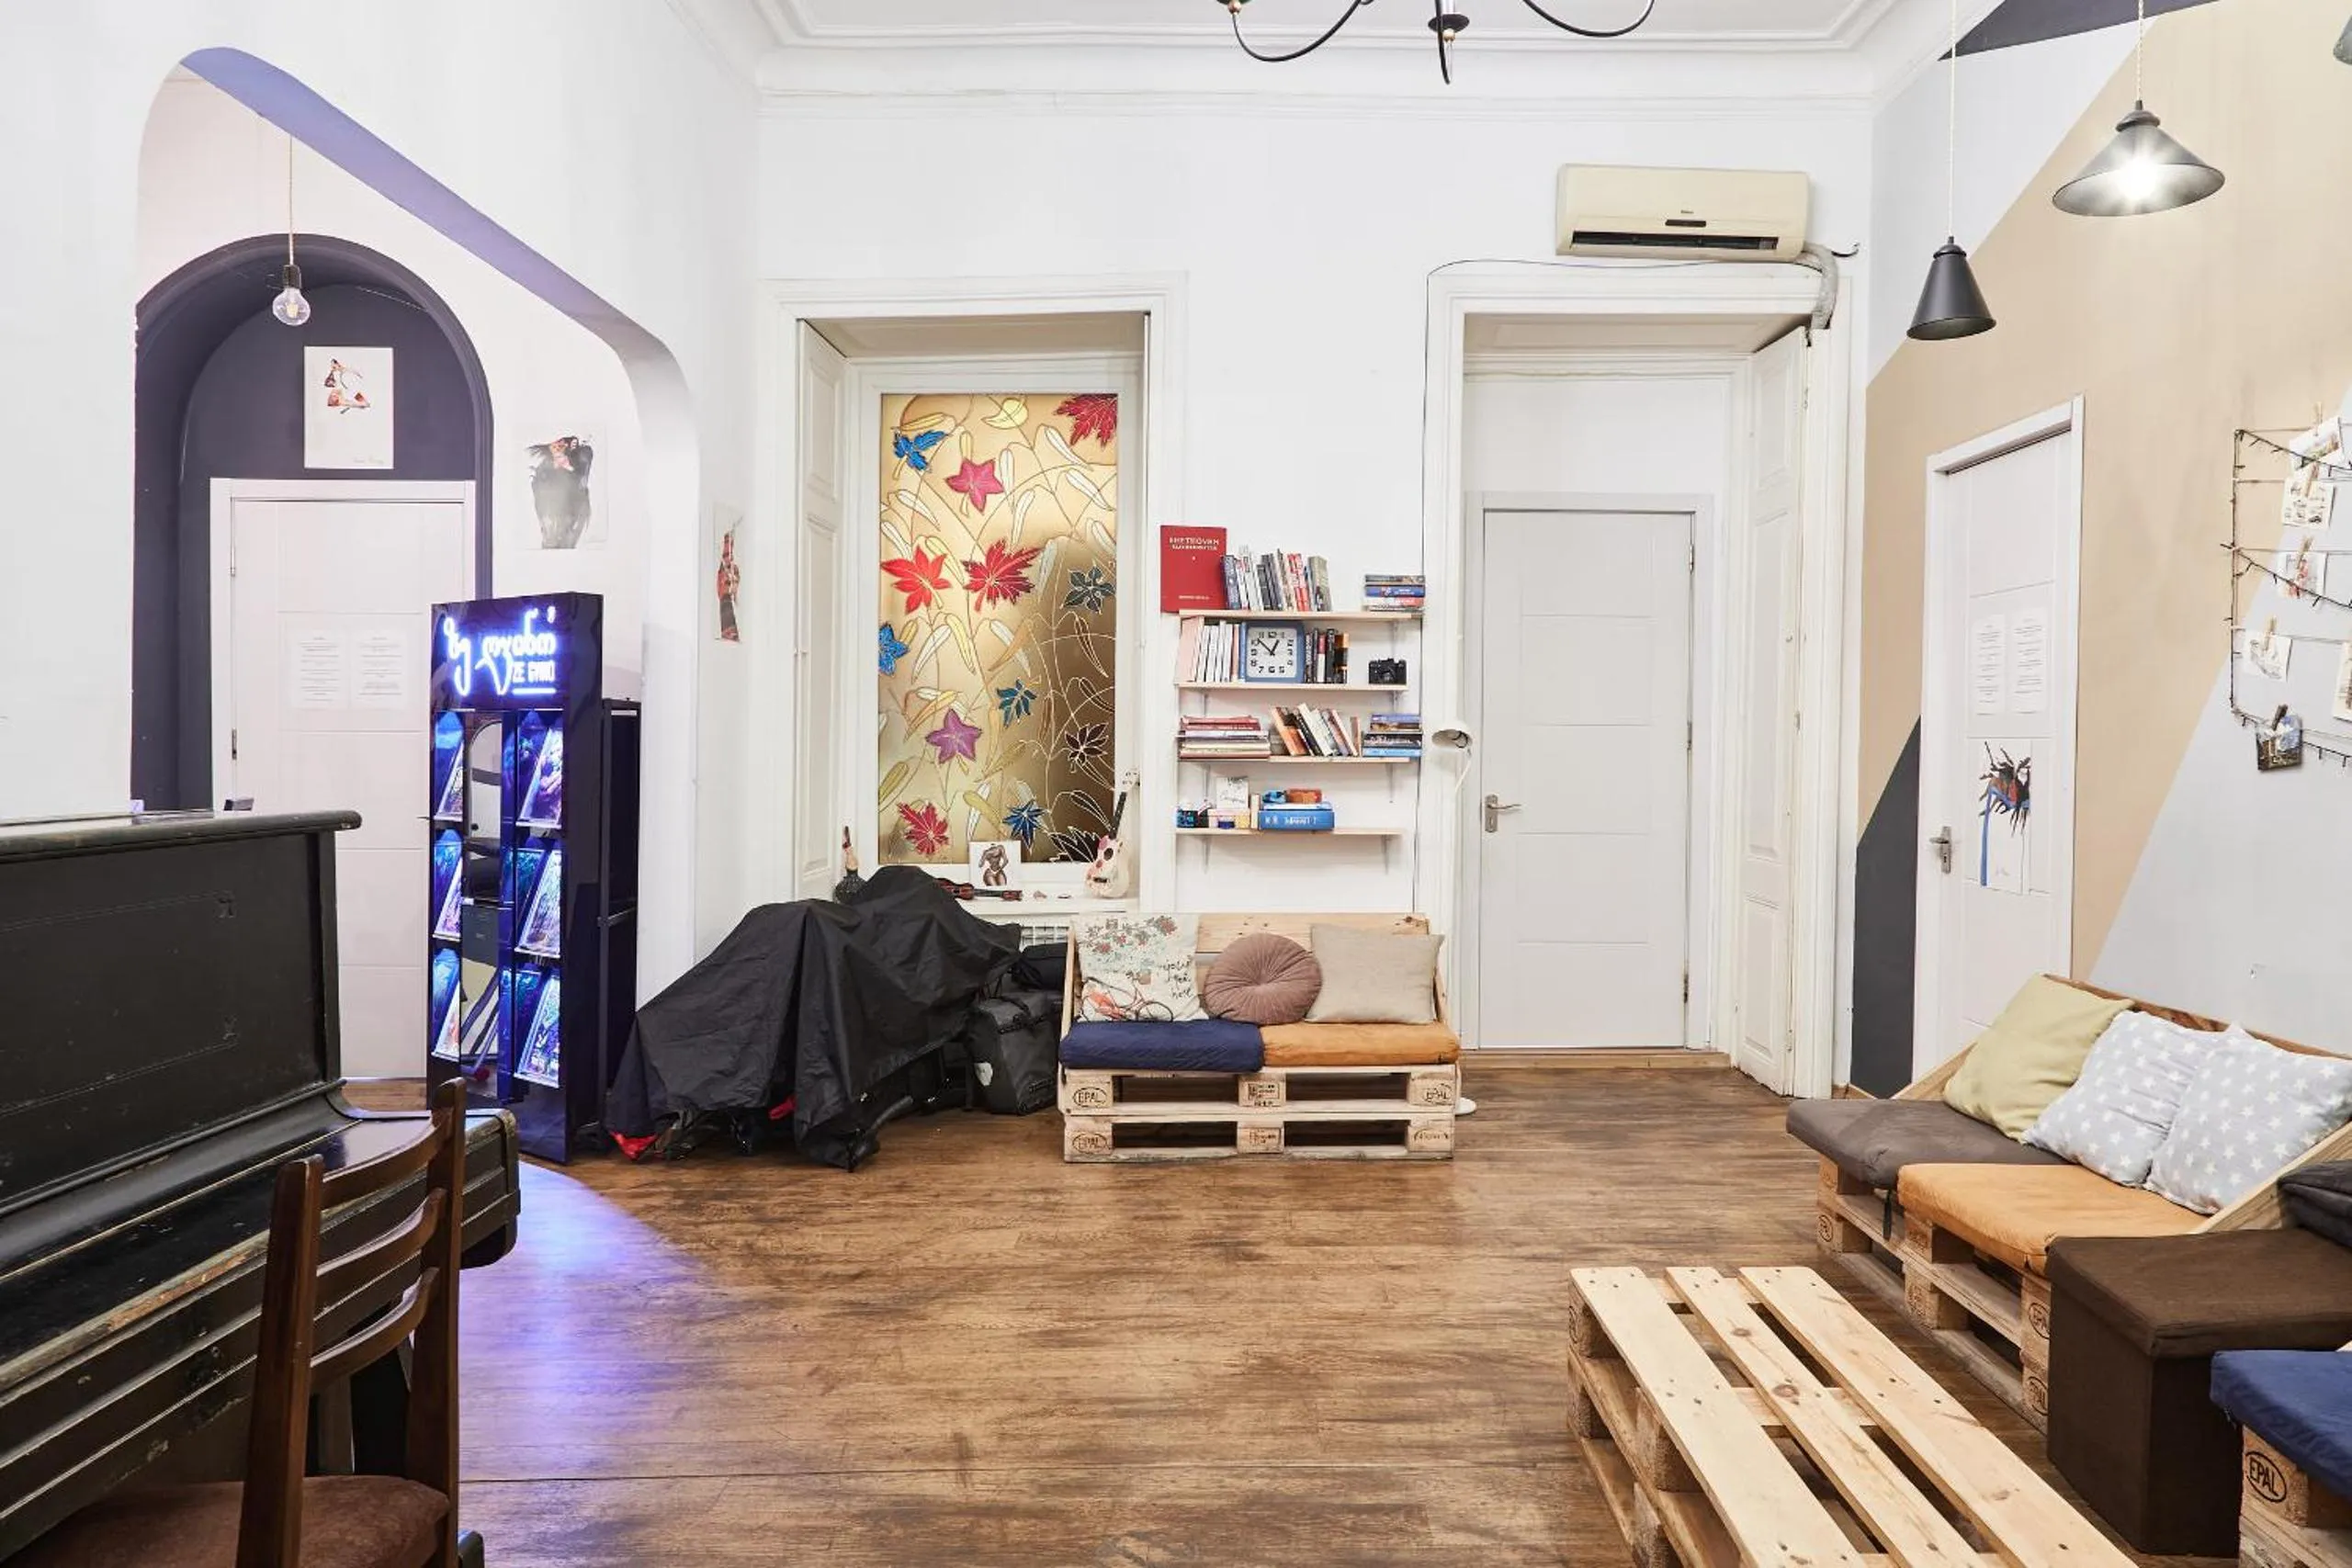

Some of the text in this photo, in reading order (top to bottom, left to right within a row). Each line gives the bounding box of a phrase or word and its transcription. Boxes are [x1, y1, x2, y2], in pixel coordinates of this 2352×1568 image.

[1078, 1091, 1102, 1103] EPAL
[1078, 1136, 1102, 1149] EPAL
[2249, 1456, 2279, 1497] EPAL
